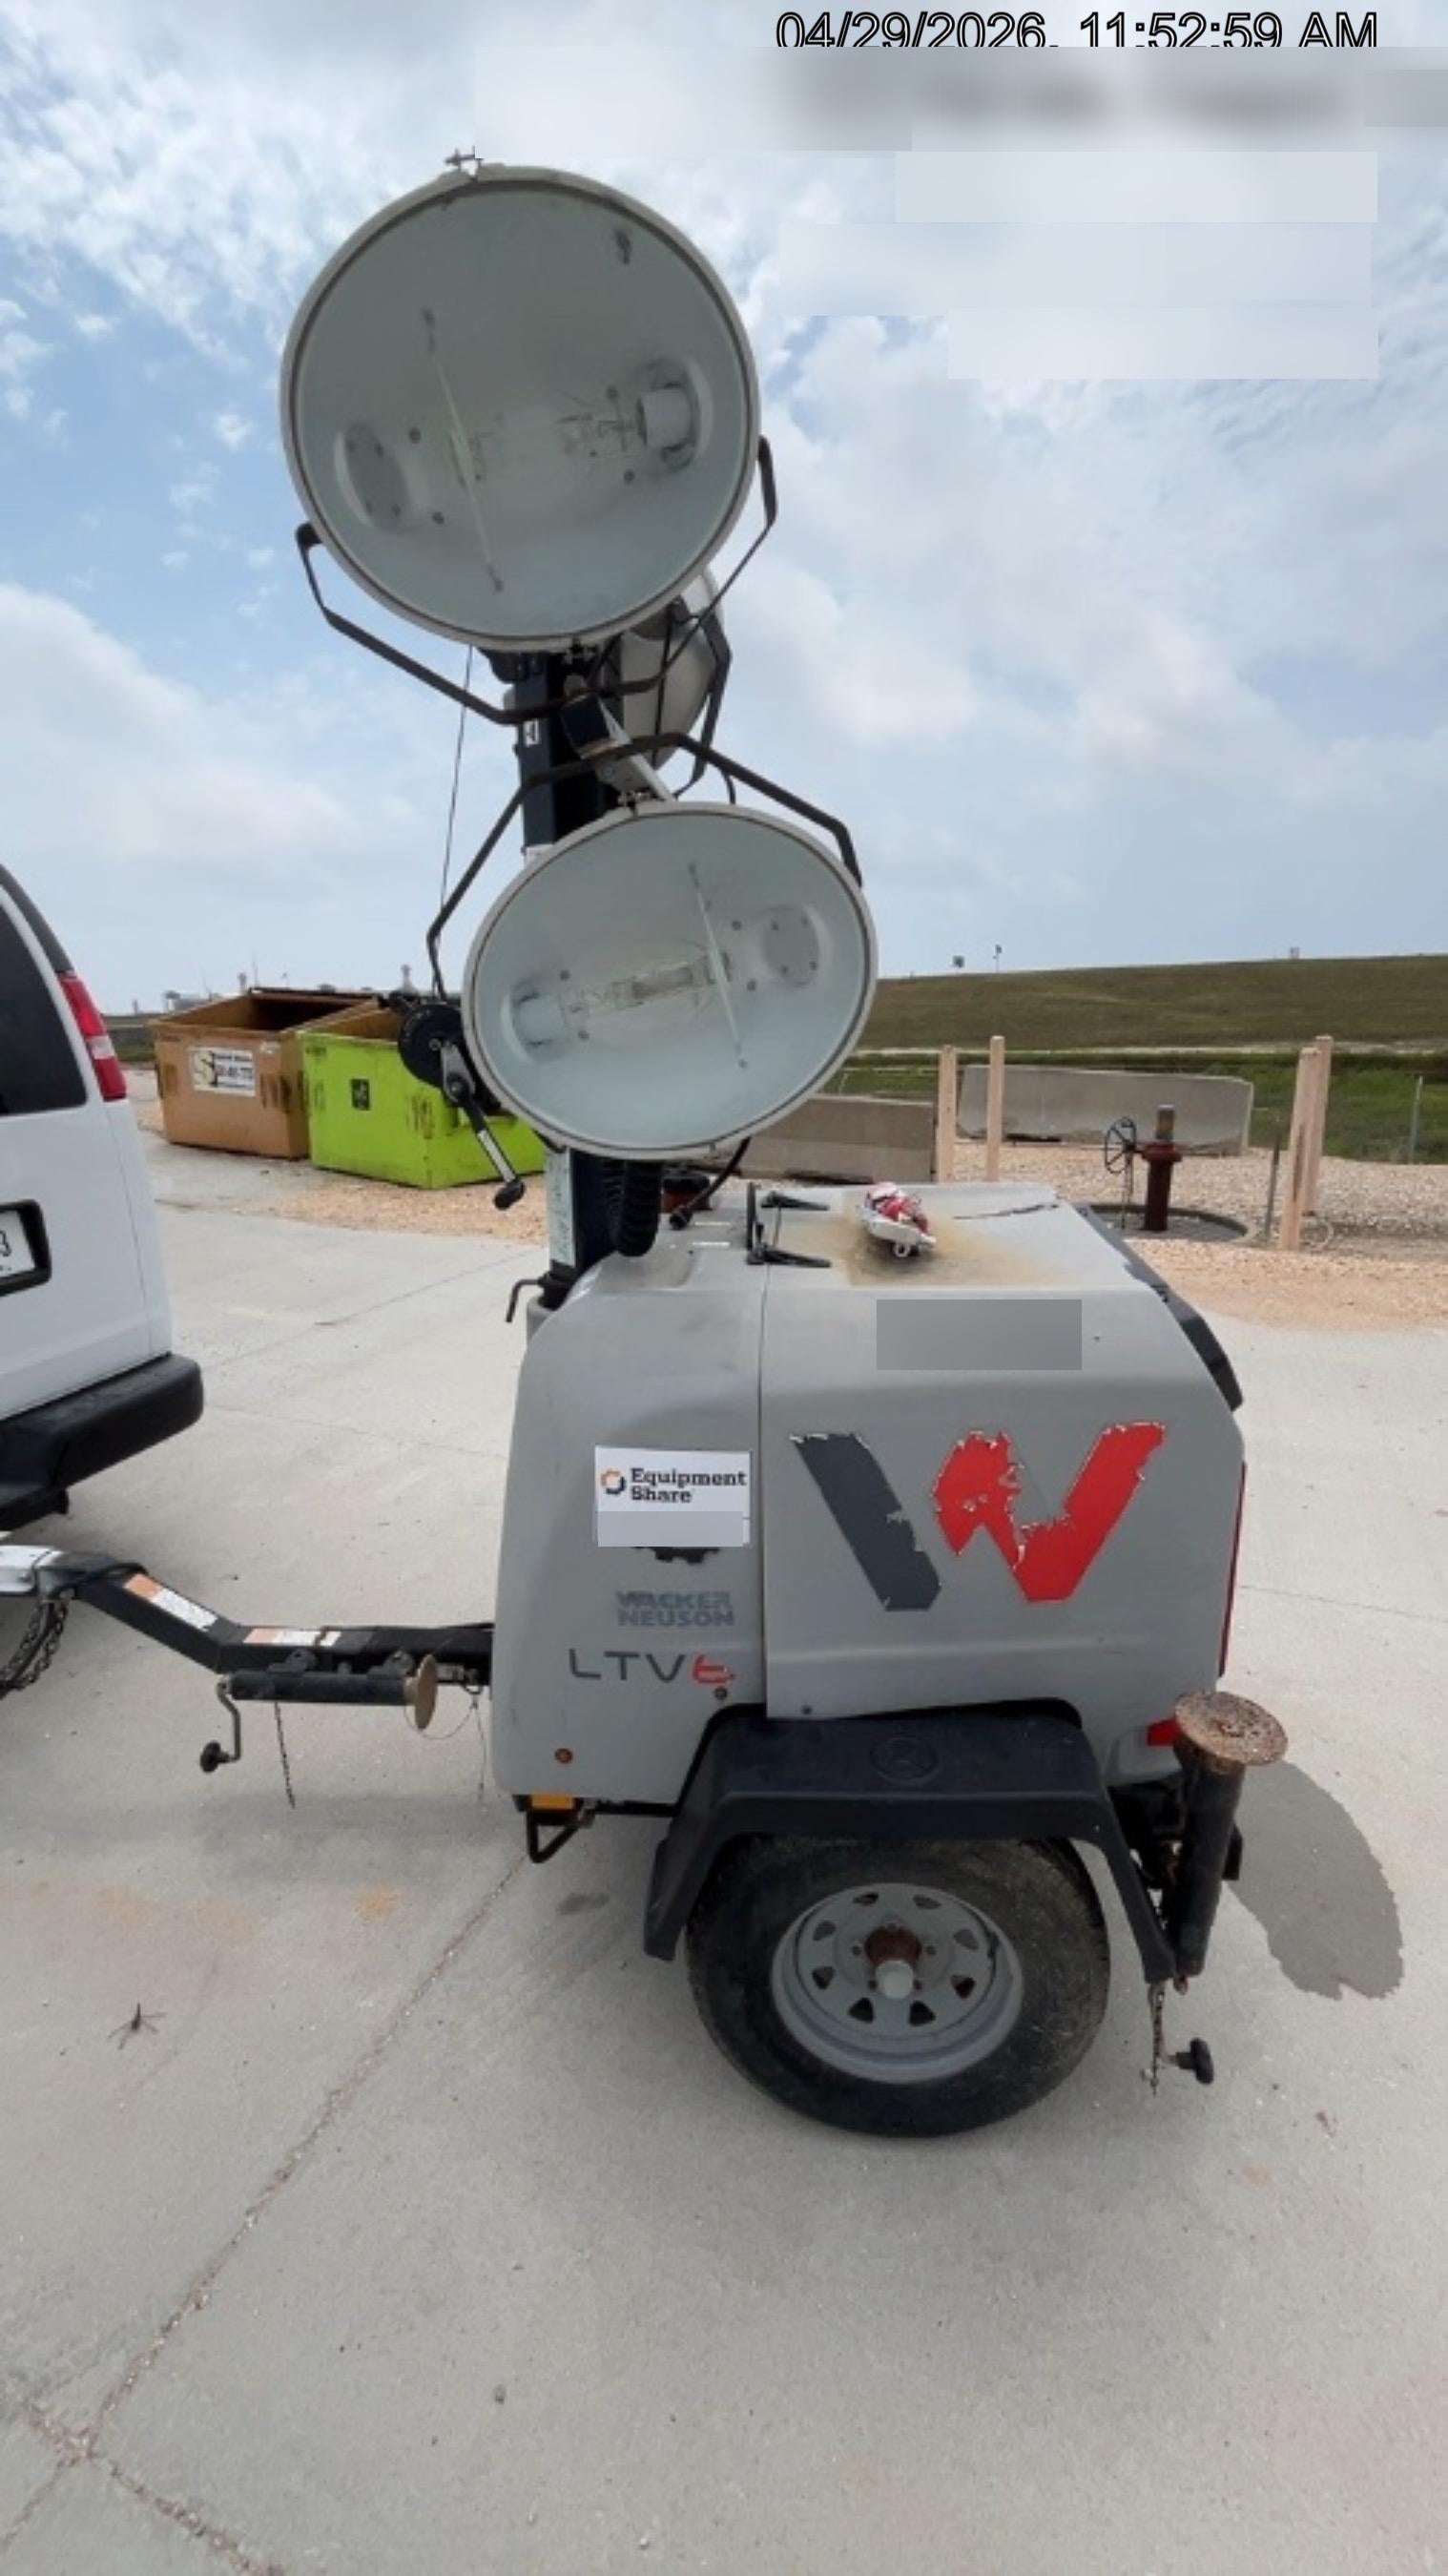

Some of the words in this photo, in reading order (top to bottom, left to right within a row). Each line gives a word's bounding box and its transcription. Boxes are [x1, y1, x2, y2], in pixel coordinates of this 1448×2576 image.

[630, 1467, 747, 1486] Equipment
[630, 1485, 693, 1504] Share
[618, 1610, 734, 1627] NEUSON
